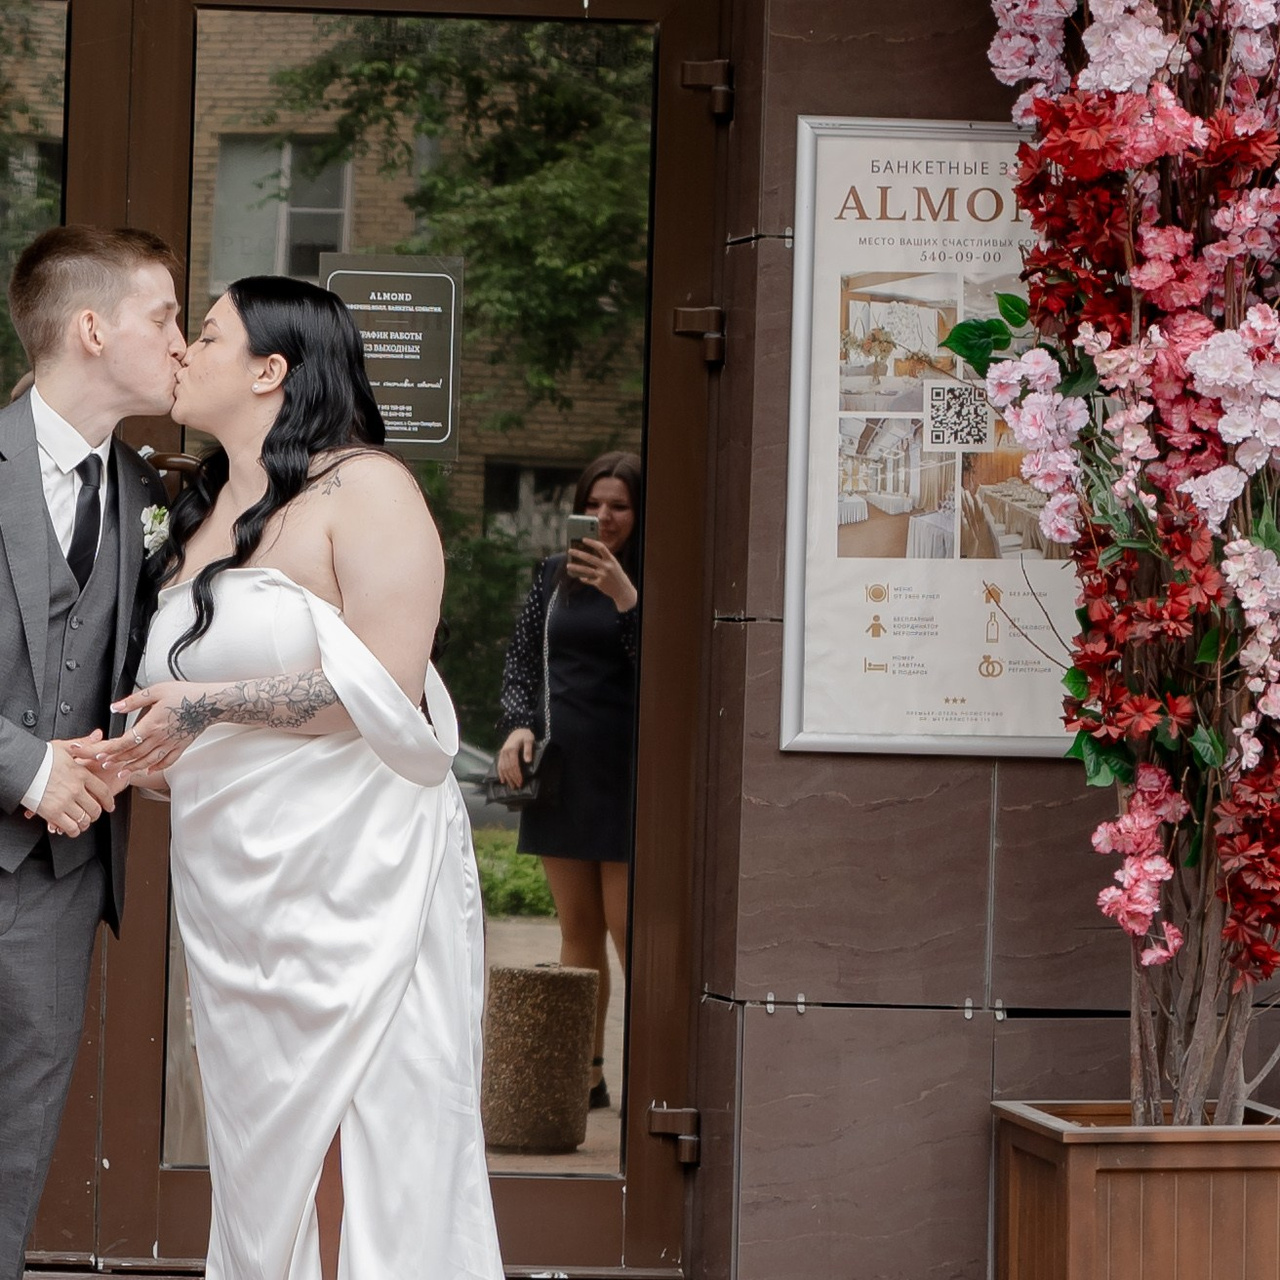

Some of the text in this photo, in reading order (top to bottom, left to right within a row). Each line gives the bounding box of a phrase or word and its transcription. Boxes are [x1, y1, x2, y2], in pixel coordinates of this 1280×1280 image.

[871, 159, 989, 176] БАНКЕТНЫЕ
[858, 237, 895, 246] МЕСТО
[899, 237, 938, 247] ВАШИХ
[942, 238, 1013, 248] СЧАСТЛИВЫХ
[919, 250, 1002, 263] 540-09-00
[369, 291, 412, 302] ALMOND
[390, 331, 423, 341] РАБОТЫ
